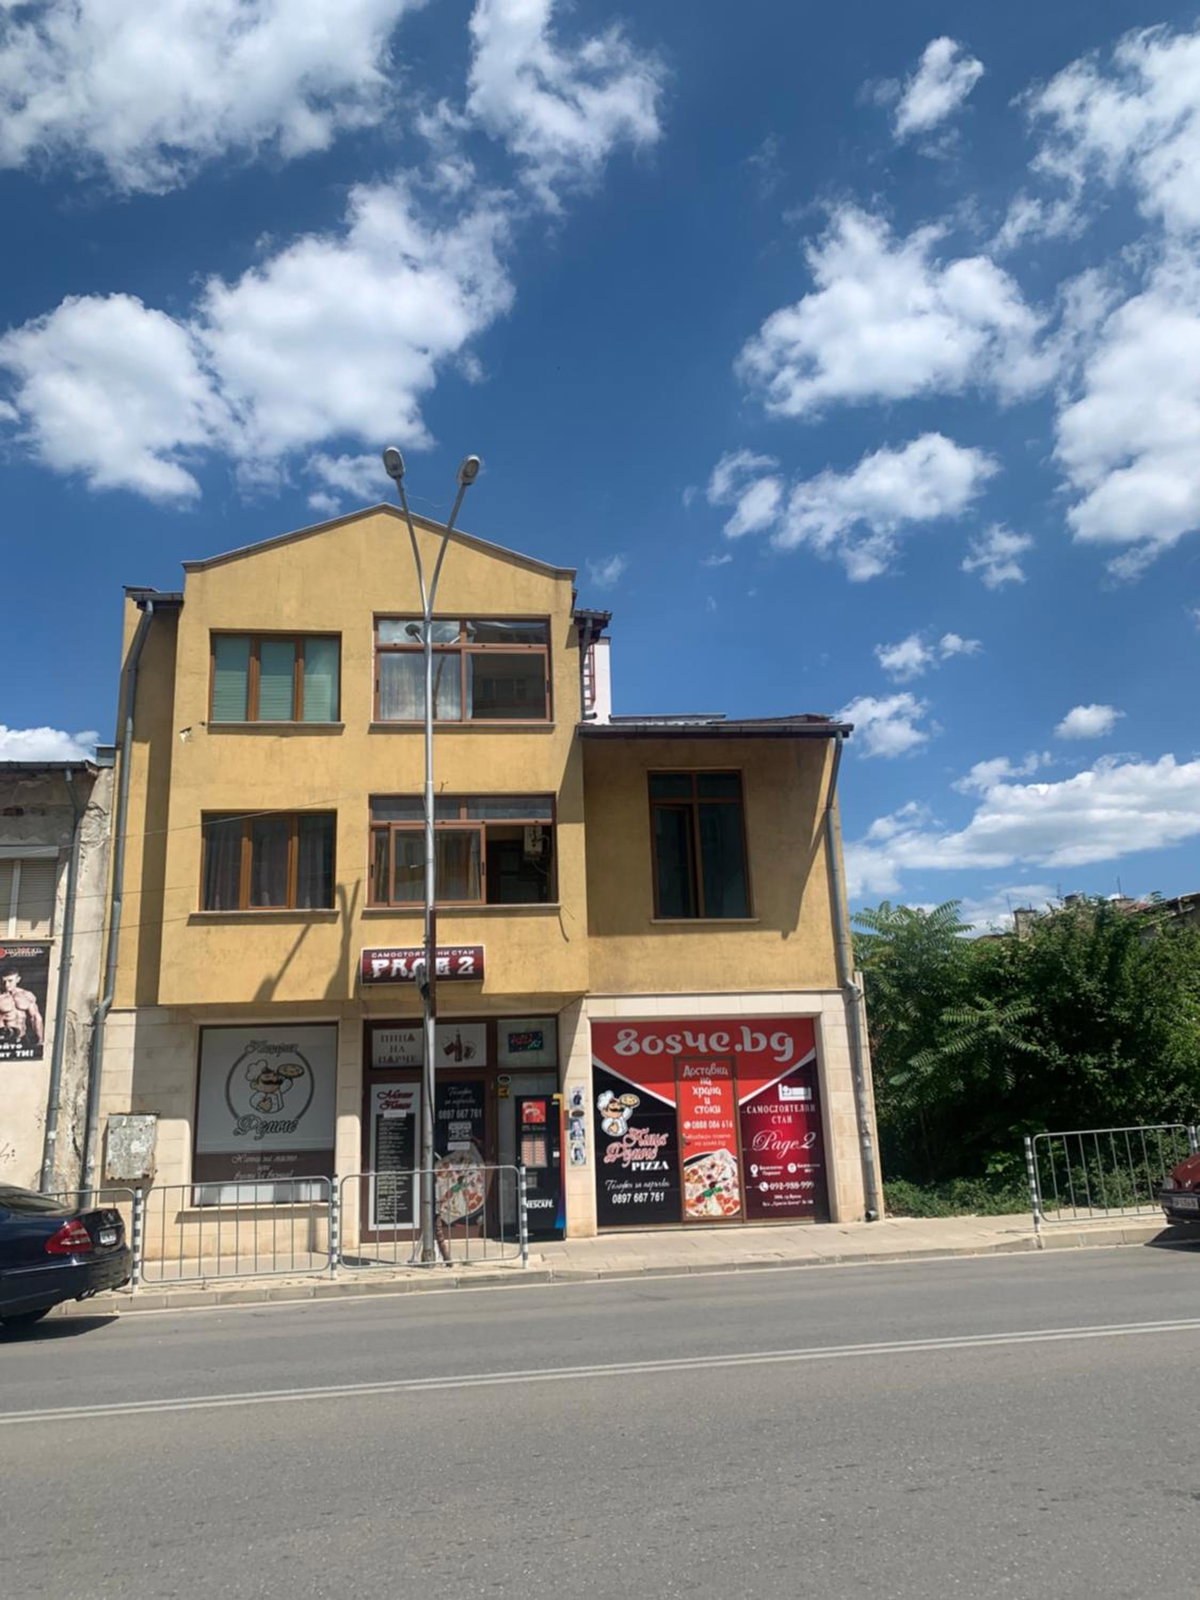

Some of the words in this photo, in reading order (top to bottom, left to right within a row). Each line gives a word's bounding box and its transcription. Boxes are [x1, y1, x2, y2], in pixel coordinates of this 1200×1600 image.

[371, 950, 449, 959] САМОСТОЯТНИ
[457, 956, 475, 974] 2
[683, 1062, 728, 1077] Доставка
[701, 1077, 712, 1086] на
[692, 1086, 722, 1098] храна
[694, 1105, 722, 1115] стоки
[771, 1116, 793, 1124] СТАИ
[752, 1129, 801, 1159] Page
[631, 1160, 670, 1171] PIZZA
[612, 1193, 632, 1204] 0897
[634, 1192, 649, 1203] 667
[650, 1192, 664, 1203] 761
